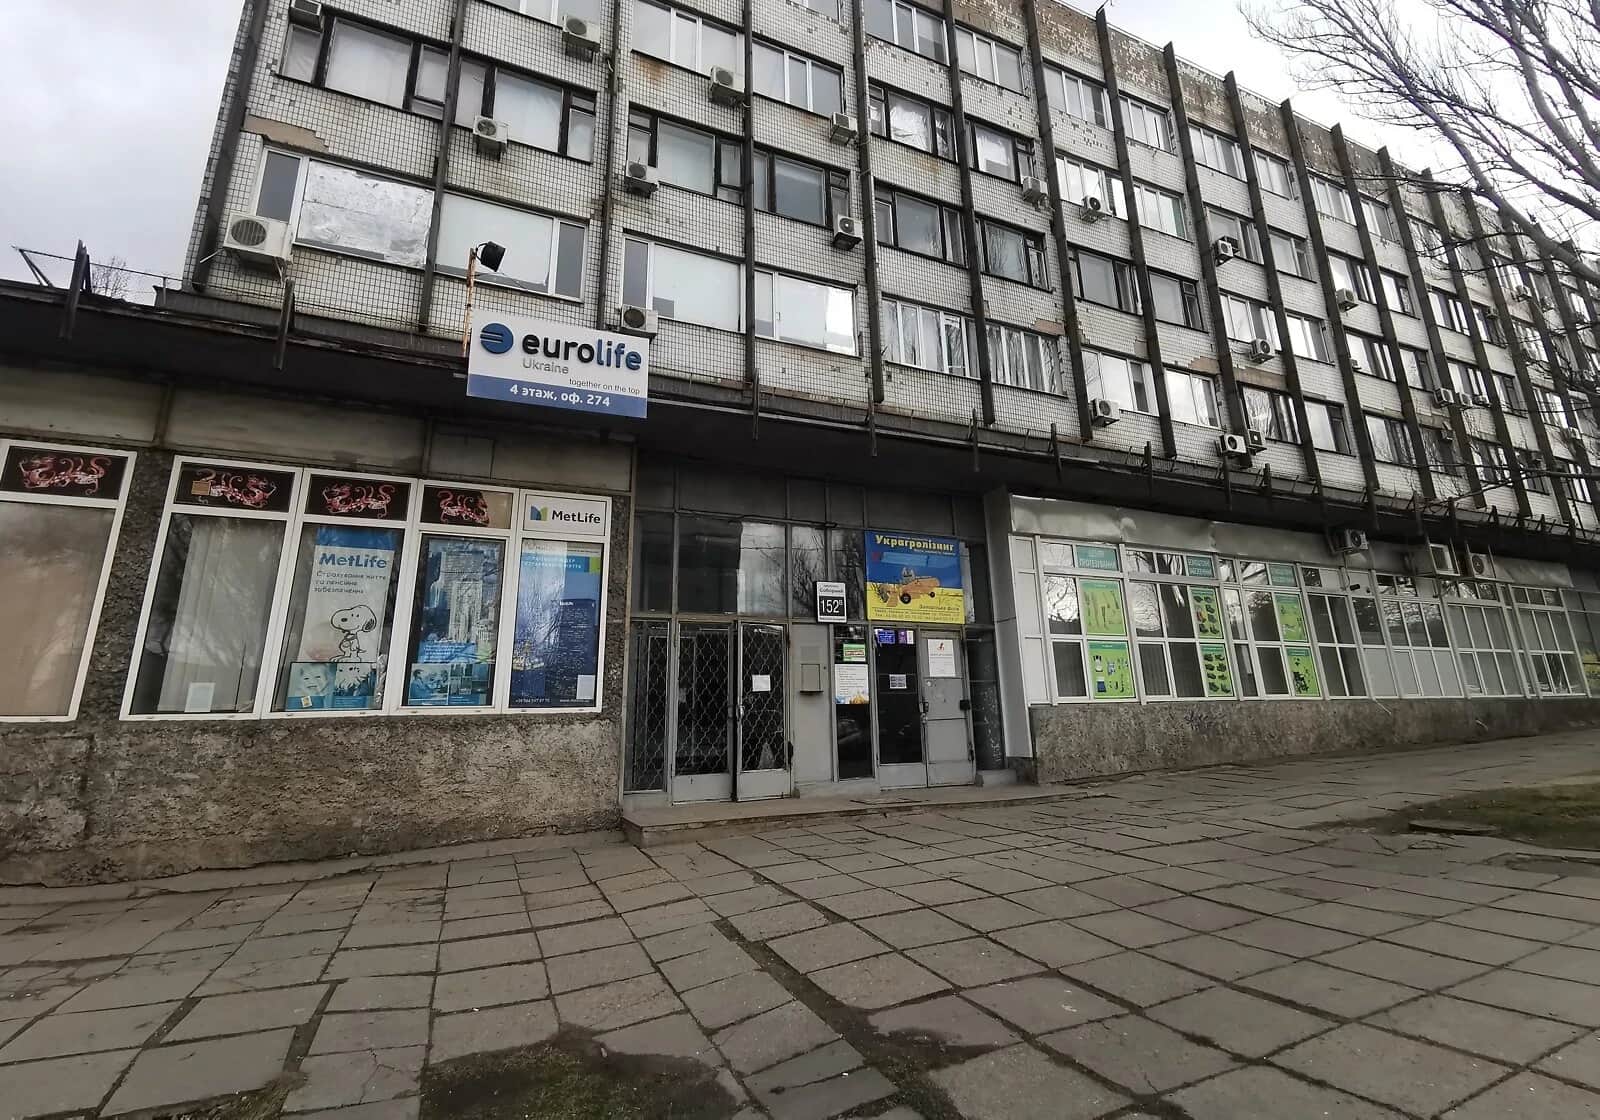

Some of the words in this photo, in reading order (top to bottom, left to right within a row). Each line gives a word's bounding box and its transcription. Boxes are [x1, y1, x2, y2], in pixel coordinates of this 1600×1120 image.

[522, 334, 642, 371] eurolife
[522, 358, 569, 375] Ukraine
[510, 384, 518, 395] 4
[522, 387, 557, 401] этаж,
[561, 391, 583, 405] оф.
[586, 394, 610, 407] 274
[569, 378, 600, 390] together
[602, 383, 613, 391] on
[614, 385, 627, 393] the
[628, 386, 641, 396] top
[551, 509, 601, 524] MetLife
[875, 534, 955, 552] Украгролізинг
[319, 552, 387, 569] MetLife
